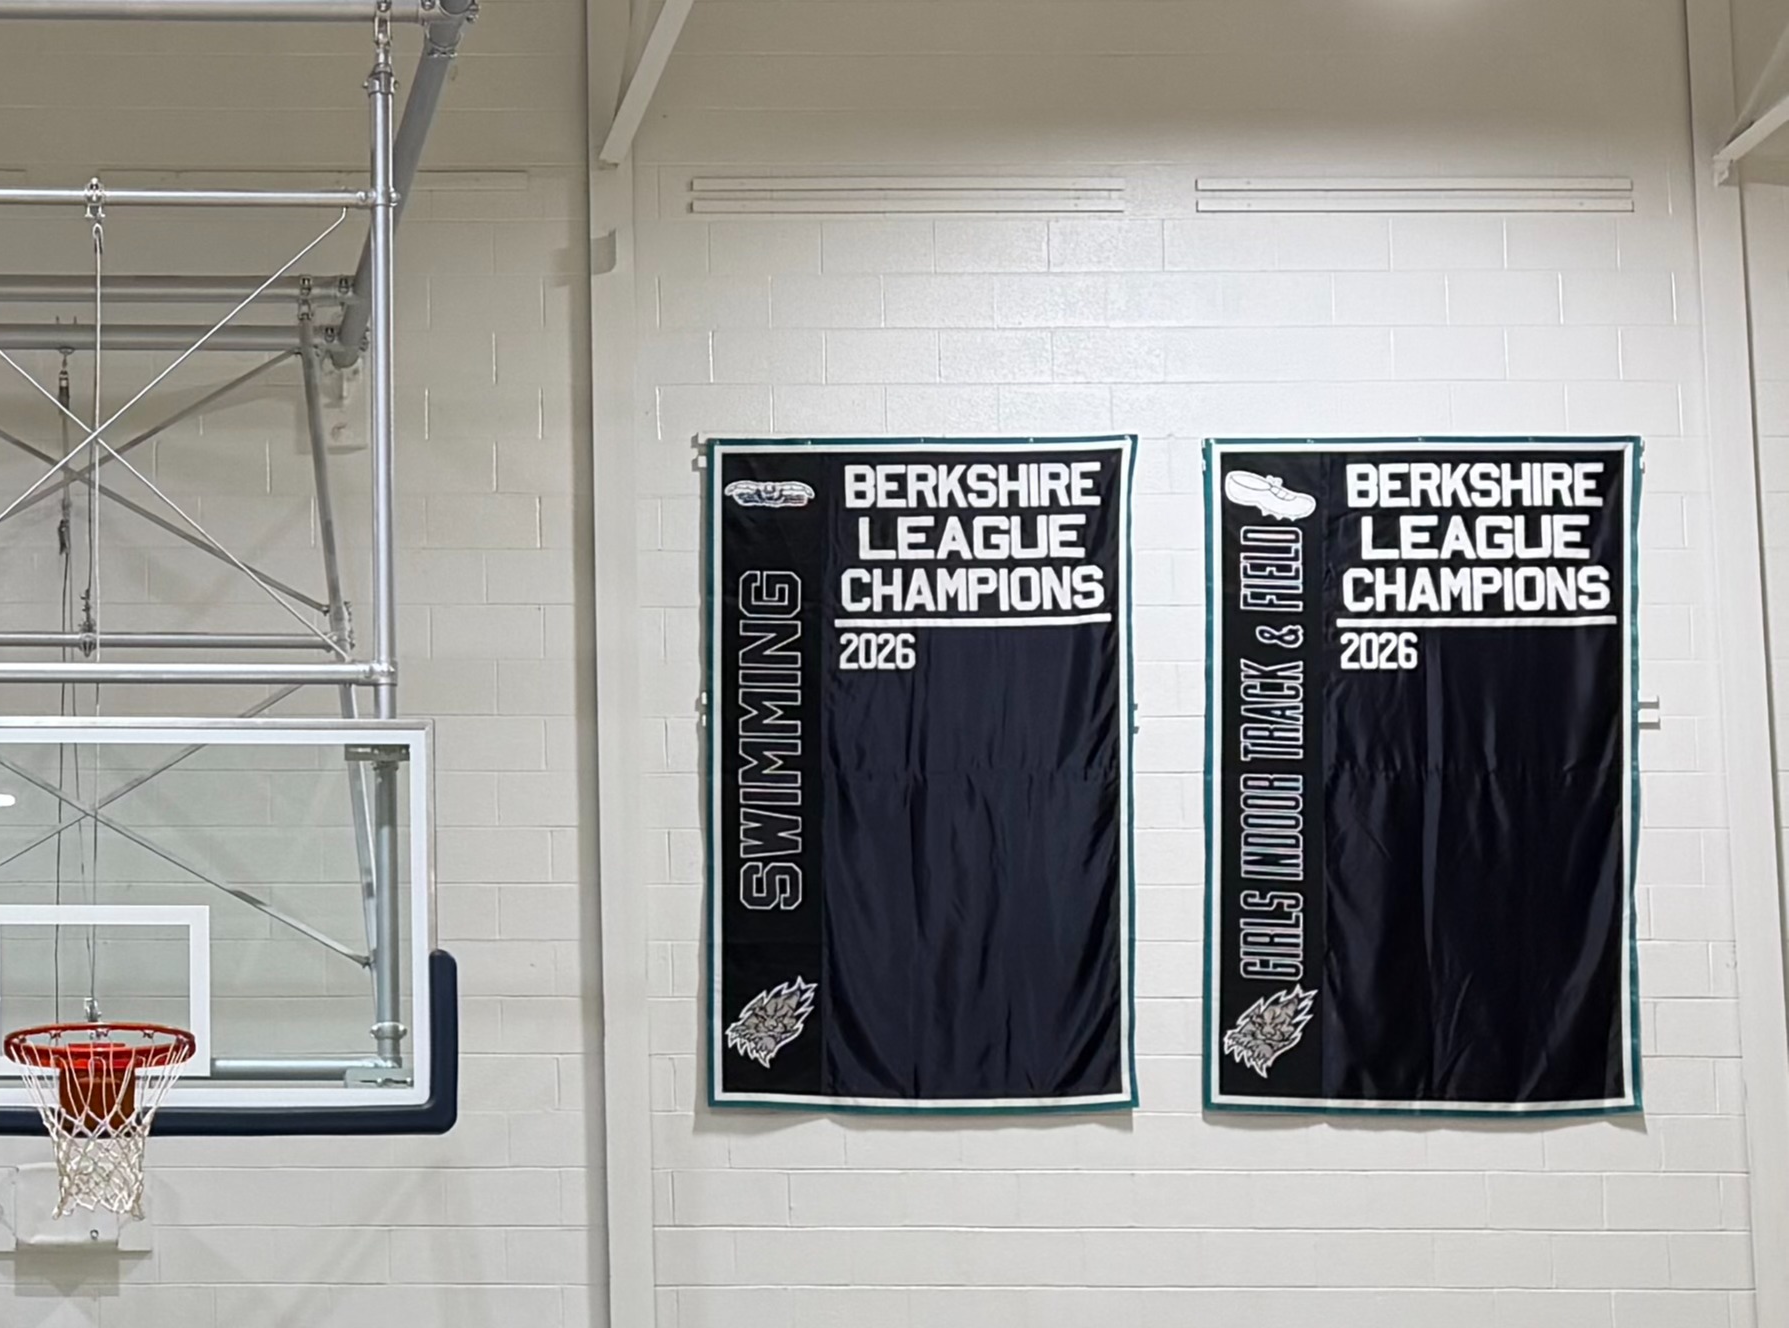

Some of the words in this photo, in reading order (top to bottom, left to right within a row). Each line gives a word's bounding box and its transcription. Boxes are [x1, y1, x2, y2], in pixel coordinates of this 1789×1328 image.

[844, 461, 1102, 509] BERKSHIRE
[1345, 462, 1604, 508] BERKSHIRE
[858, 513, 1087, 561] LEAGUE
[1360, 514, 1591, 561] LEAGUE
[840, 564, 1105, 613] CHAMPIONS
[1239, 525, 1304, 613] FIELD
[1342, 565, 1611, 613] CHAMPIONS
[839, 632, 916, 670] 2026
[1254, 624, 1305, 649] &
[1339, 631, 1418, 670] 2026
[1239, 657, 1304, 762] TRACK
[737, 570, 803, 910] SWIMMING
[1239, 773, 1304, 881] INDOOR
[1239, 889, 1304, 981] GIRLS
